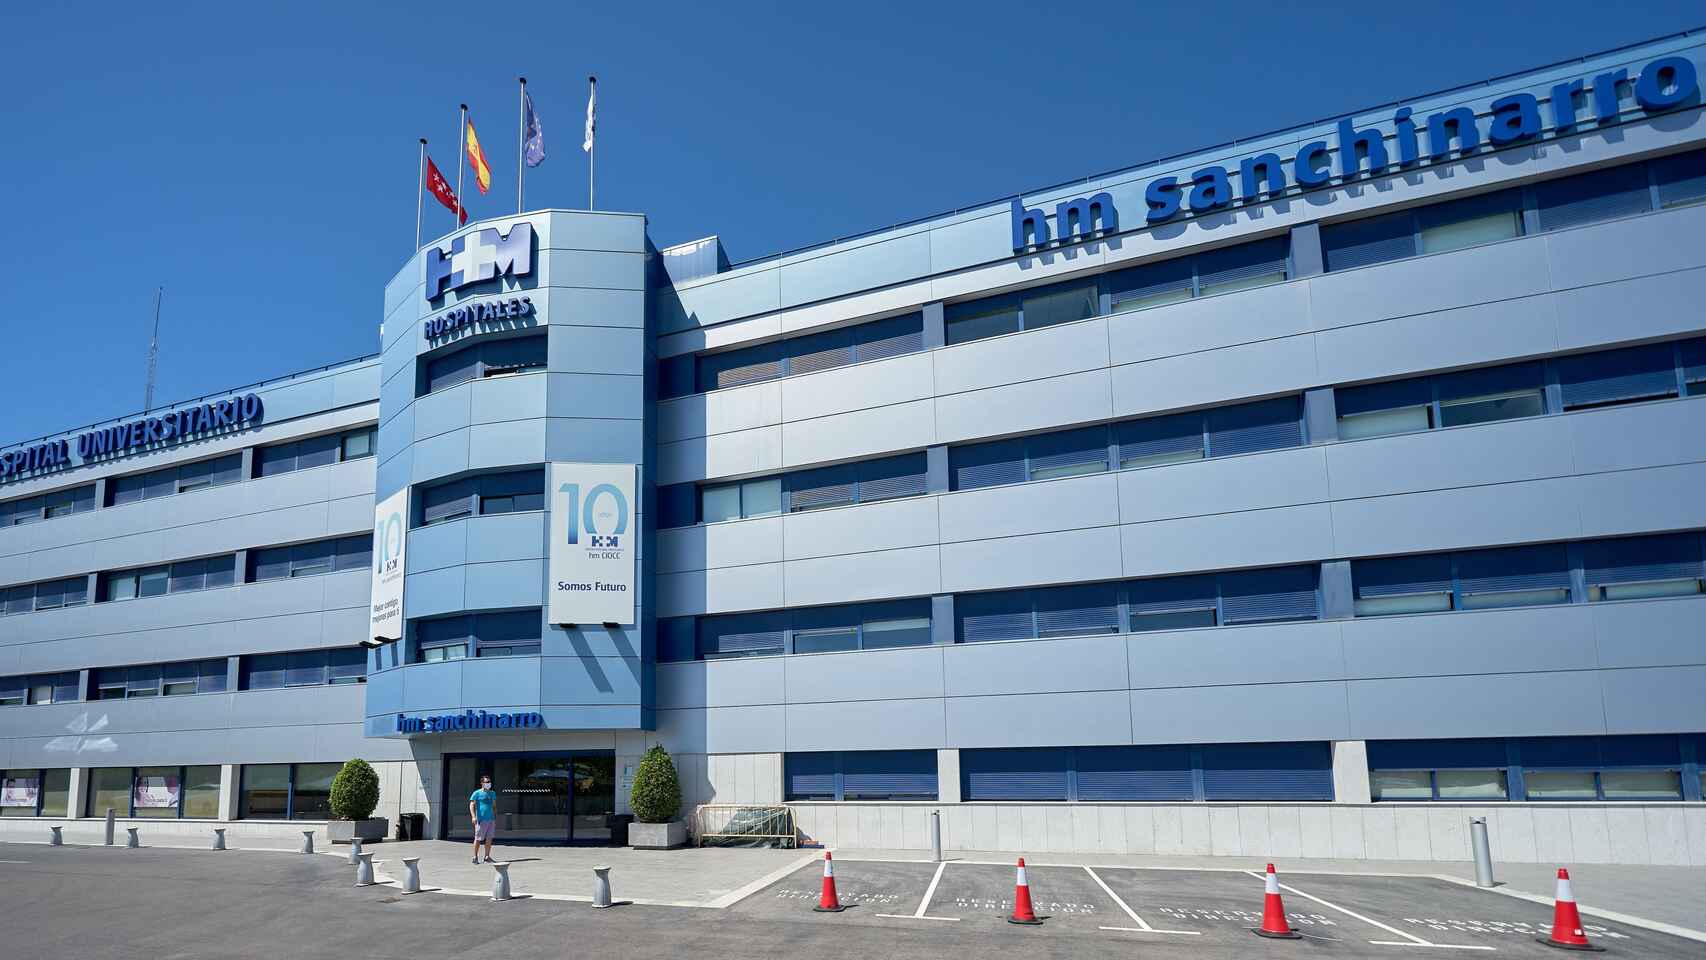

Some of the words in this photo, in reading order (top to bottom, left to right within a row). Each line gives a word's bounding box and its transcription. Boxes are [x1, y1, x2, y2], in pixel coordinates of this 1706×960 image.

[1010, 197, 1118, 254] hm
[1145, 54, 1700, 224] sanchinarro
[424, 296, 532, 339] HOSPITALES
[77, 392, 262, 457] UNIVERSITARIO
[559, 483, 628, 545] 10
[558, 581, 591, 592] Somos
[595, 581, 627, 592] Futuro
[397, 713, 421, 732] hm
[425, 709, 543, 731] sanchinarro
[956, 897, 1094, 909] RESEVADO
